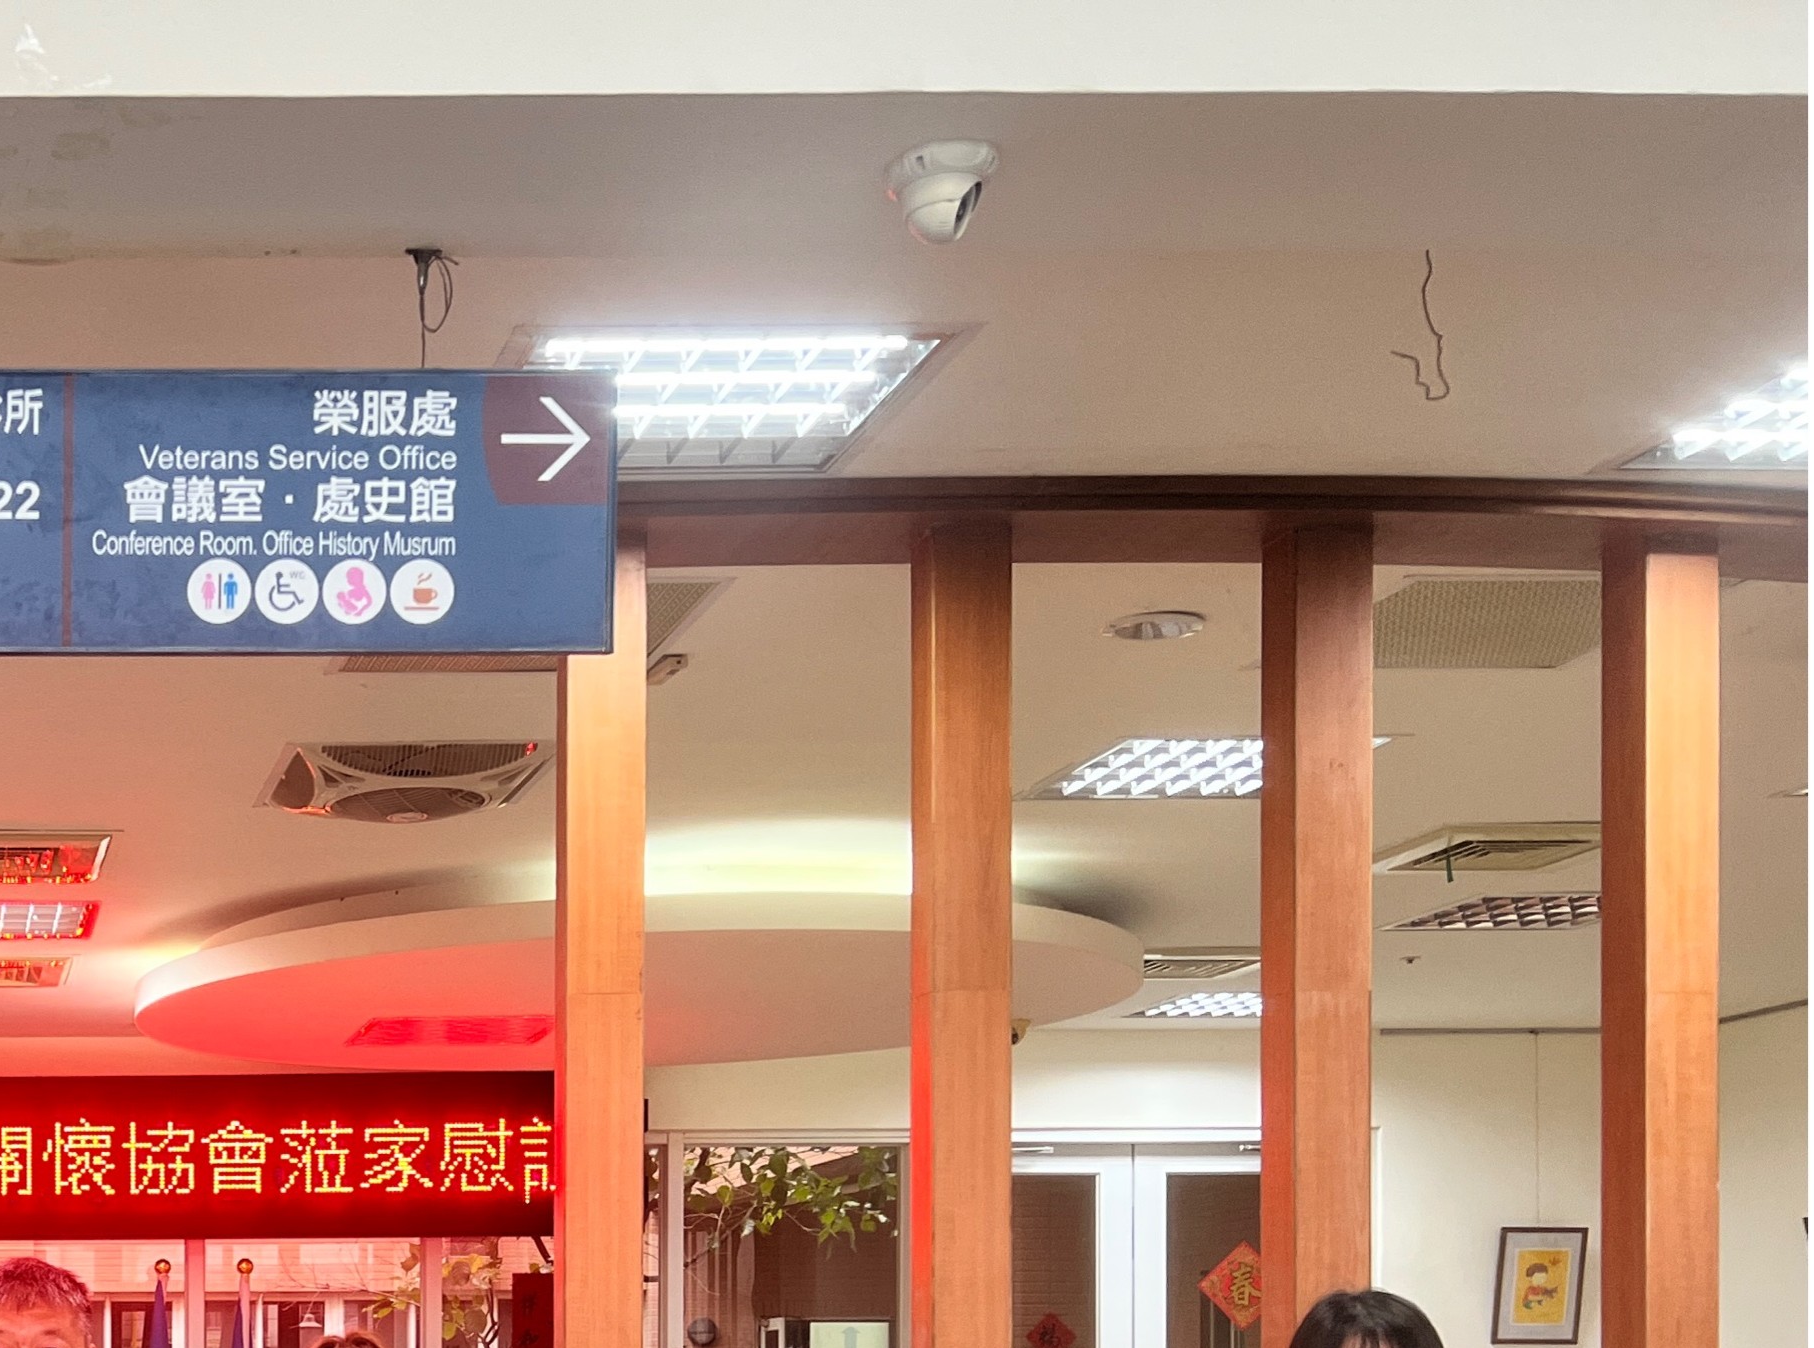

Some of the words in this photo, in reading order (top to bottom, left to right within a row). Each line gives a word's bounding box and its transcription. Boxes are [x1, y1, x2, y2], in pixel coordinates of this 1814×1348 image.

[313, 389, 458, 437] 榮服處
[139, 444, 259, 471] Veterans
[268, 444, 369, 471] Service
[379, 444, 458, 471] Office
[92, 530, 195, 556] Conference
[199, 530, 257, 556] Room.
[263, 530, 314, 556] Office
[318, 530, 379, 561] History
[384, 530, 457, 557] Musrum
[1229, 1263, 1263, 1306] 春
